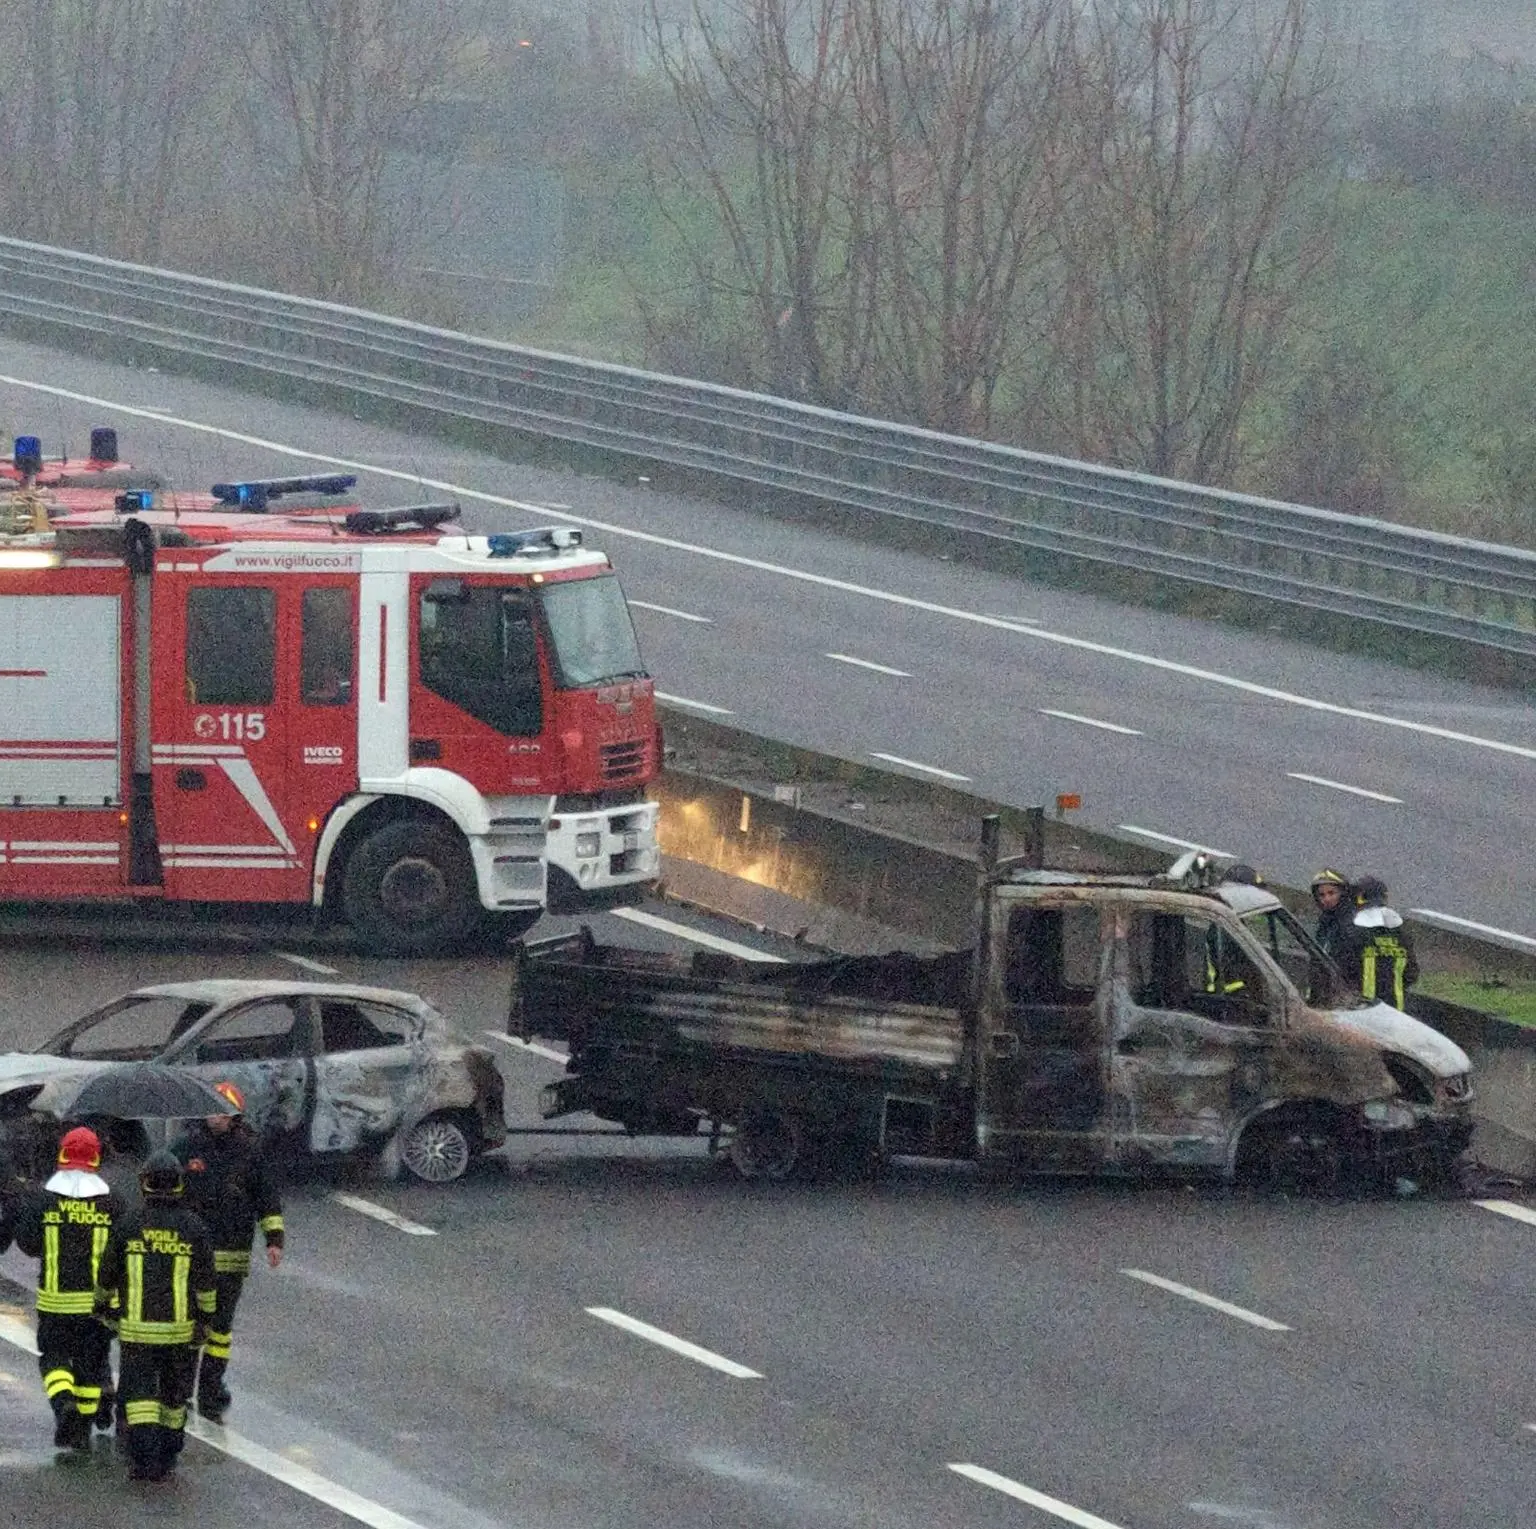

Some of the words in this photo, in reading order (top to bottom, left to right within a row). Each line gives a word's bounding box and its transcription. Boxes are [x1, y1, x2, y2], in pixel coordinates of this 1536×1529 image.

[218, 712, 266, 741] 115
[304, 747, 343, 756] IVECO
[58, 1200, 97, 1212] VIGILI
[142, 1229, 179, 1242] VIGILI
